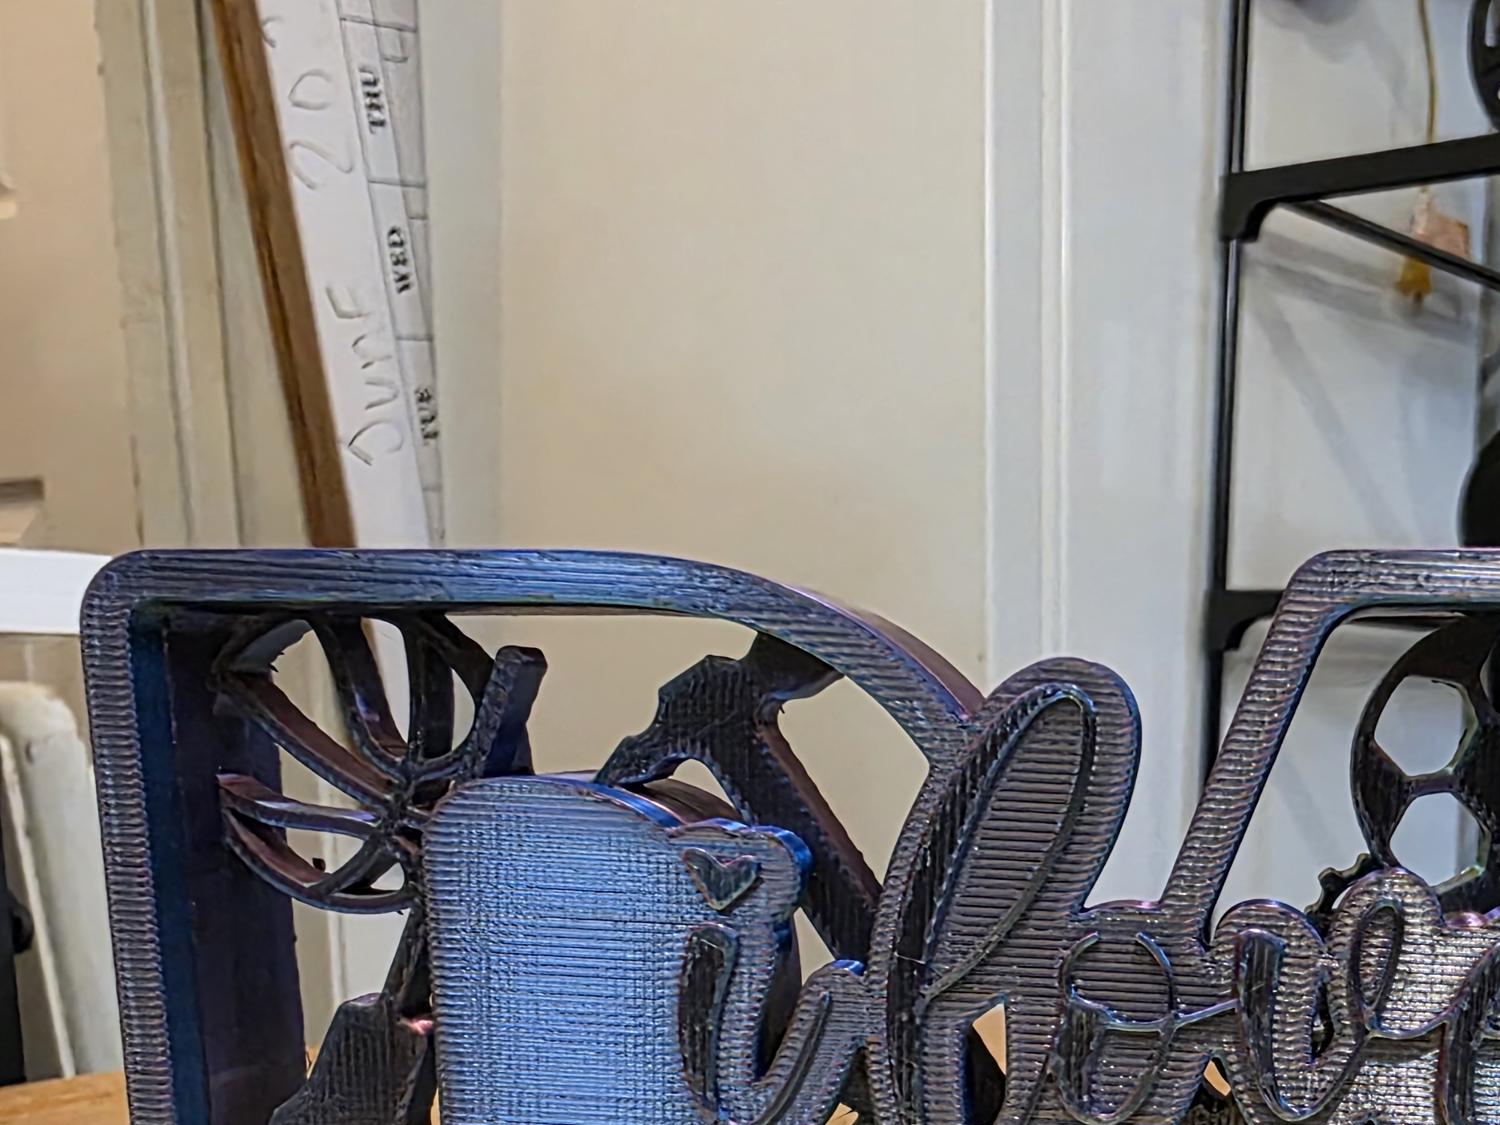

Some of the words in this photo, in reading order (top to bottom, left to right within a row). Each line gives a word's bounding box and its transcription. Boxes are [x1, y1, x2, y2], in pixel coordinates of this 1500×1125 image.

[358, 66, 386, 134] THU
[387, 226, 413, 294] WED
[415, 387, 439, 446] TUE
